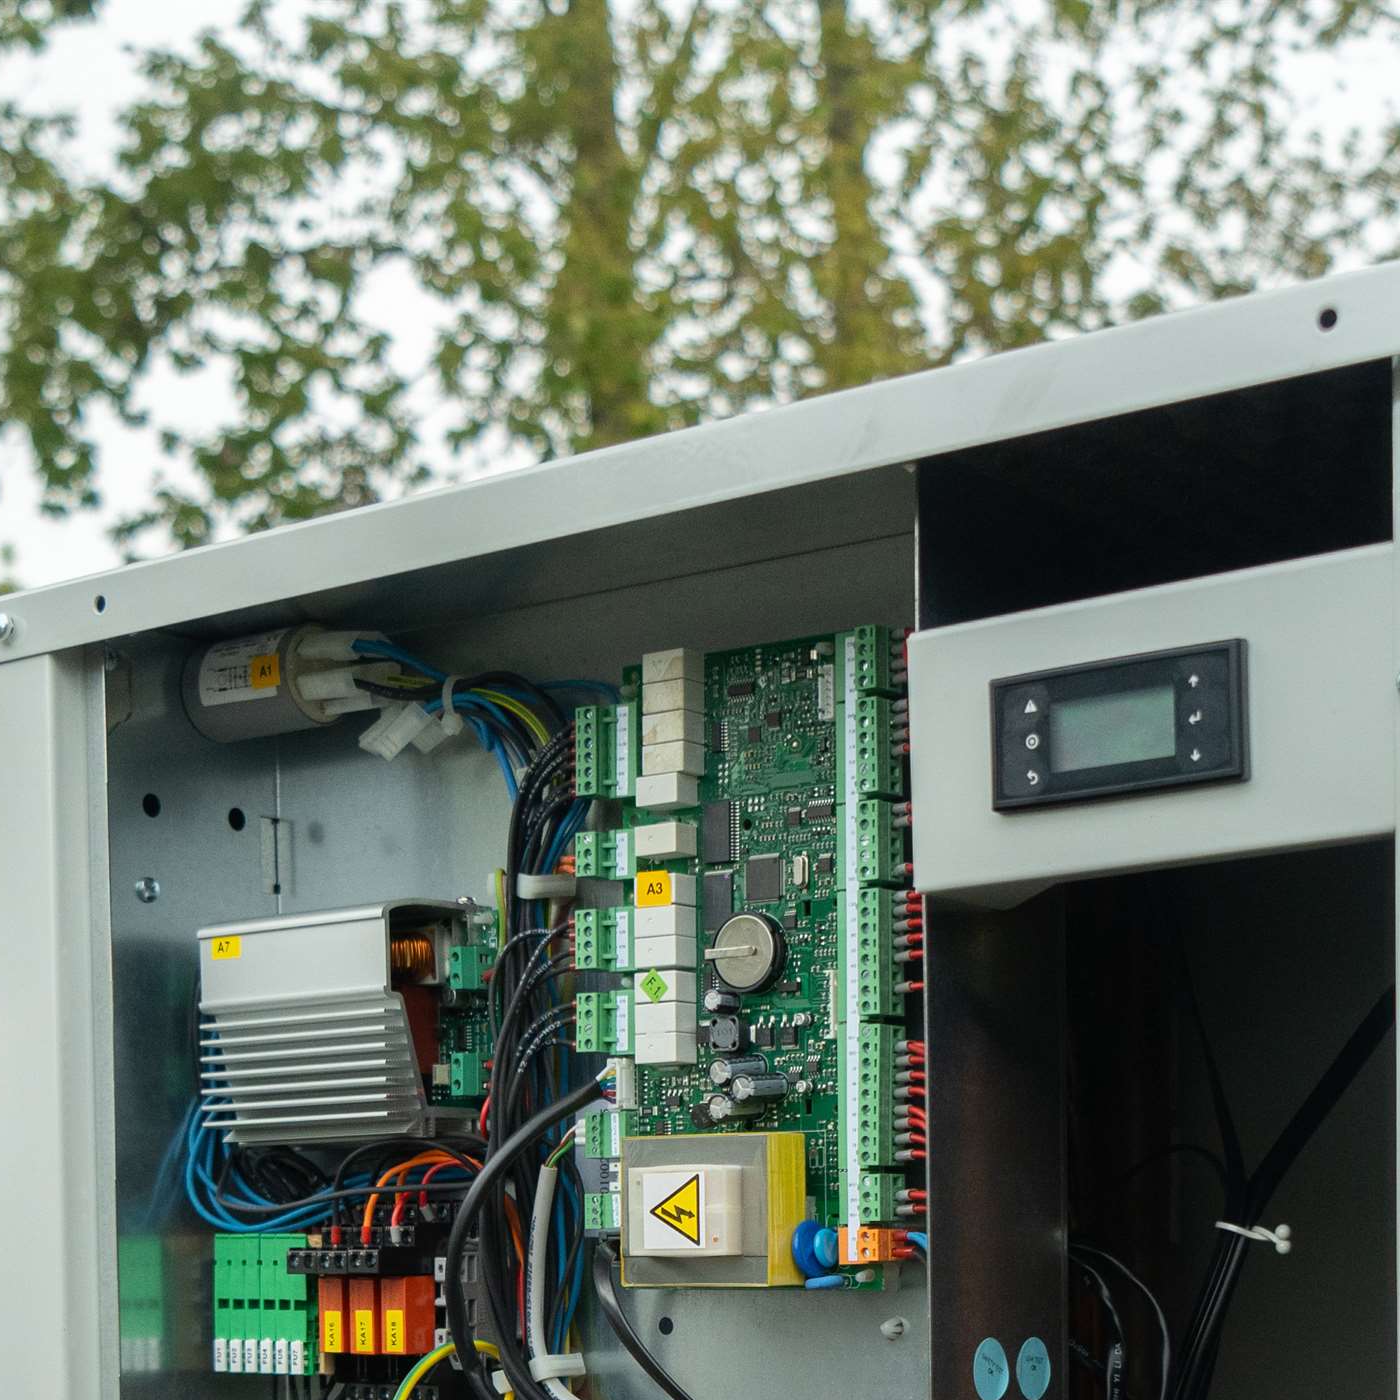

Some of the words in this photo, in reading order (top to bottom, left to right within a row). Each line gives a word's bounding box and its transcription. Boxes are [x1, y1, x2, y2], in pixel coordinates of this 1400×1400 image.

[258, 664, 273, 679] A1
[646, 882, 663, 896] A3
[217, 941, 231, 953] A7
